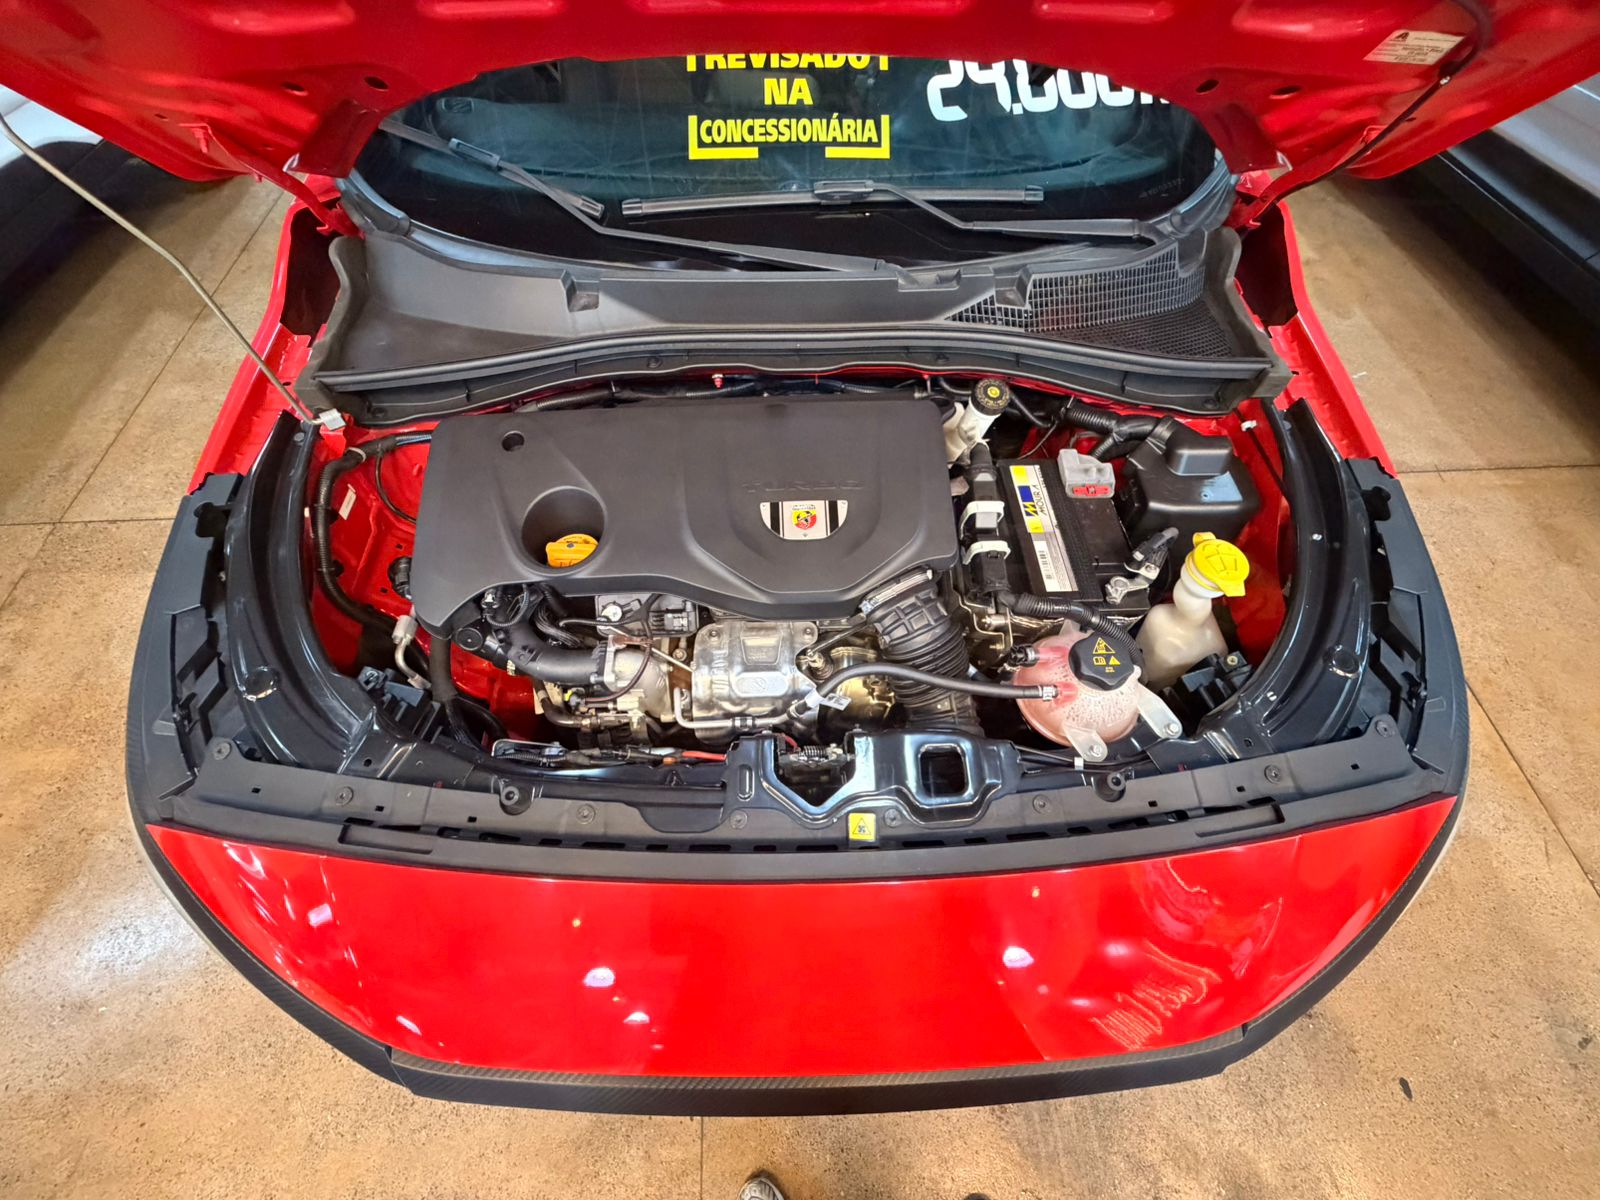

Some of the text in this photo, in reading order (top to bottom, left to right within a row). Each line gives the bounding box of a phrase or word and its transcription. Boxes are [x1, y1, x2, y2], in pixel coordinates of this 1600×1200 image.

[764, 78, 814, 105] NA
[700, 112, 879, 144] CONCESSIONÁRIA
[1031, 484, 1048, 517] MOURA
